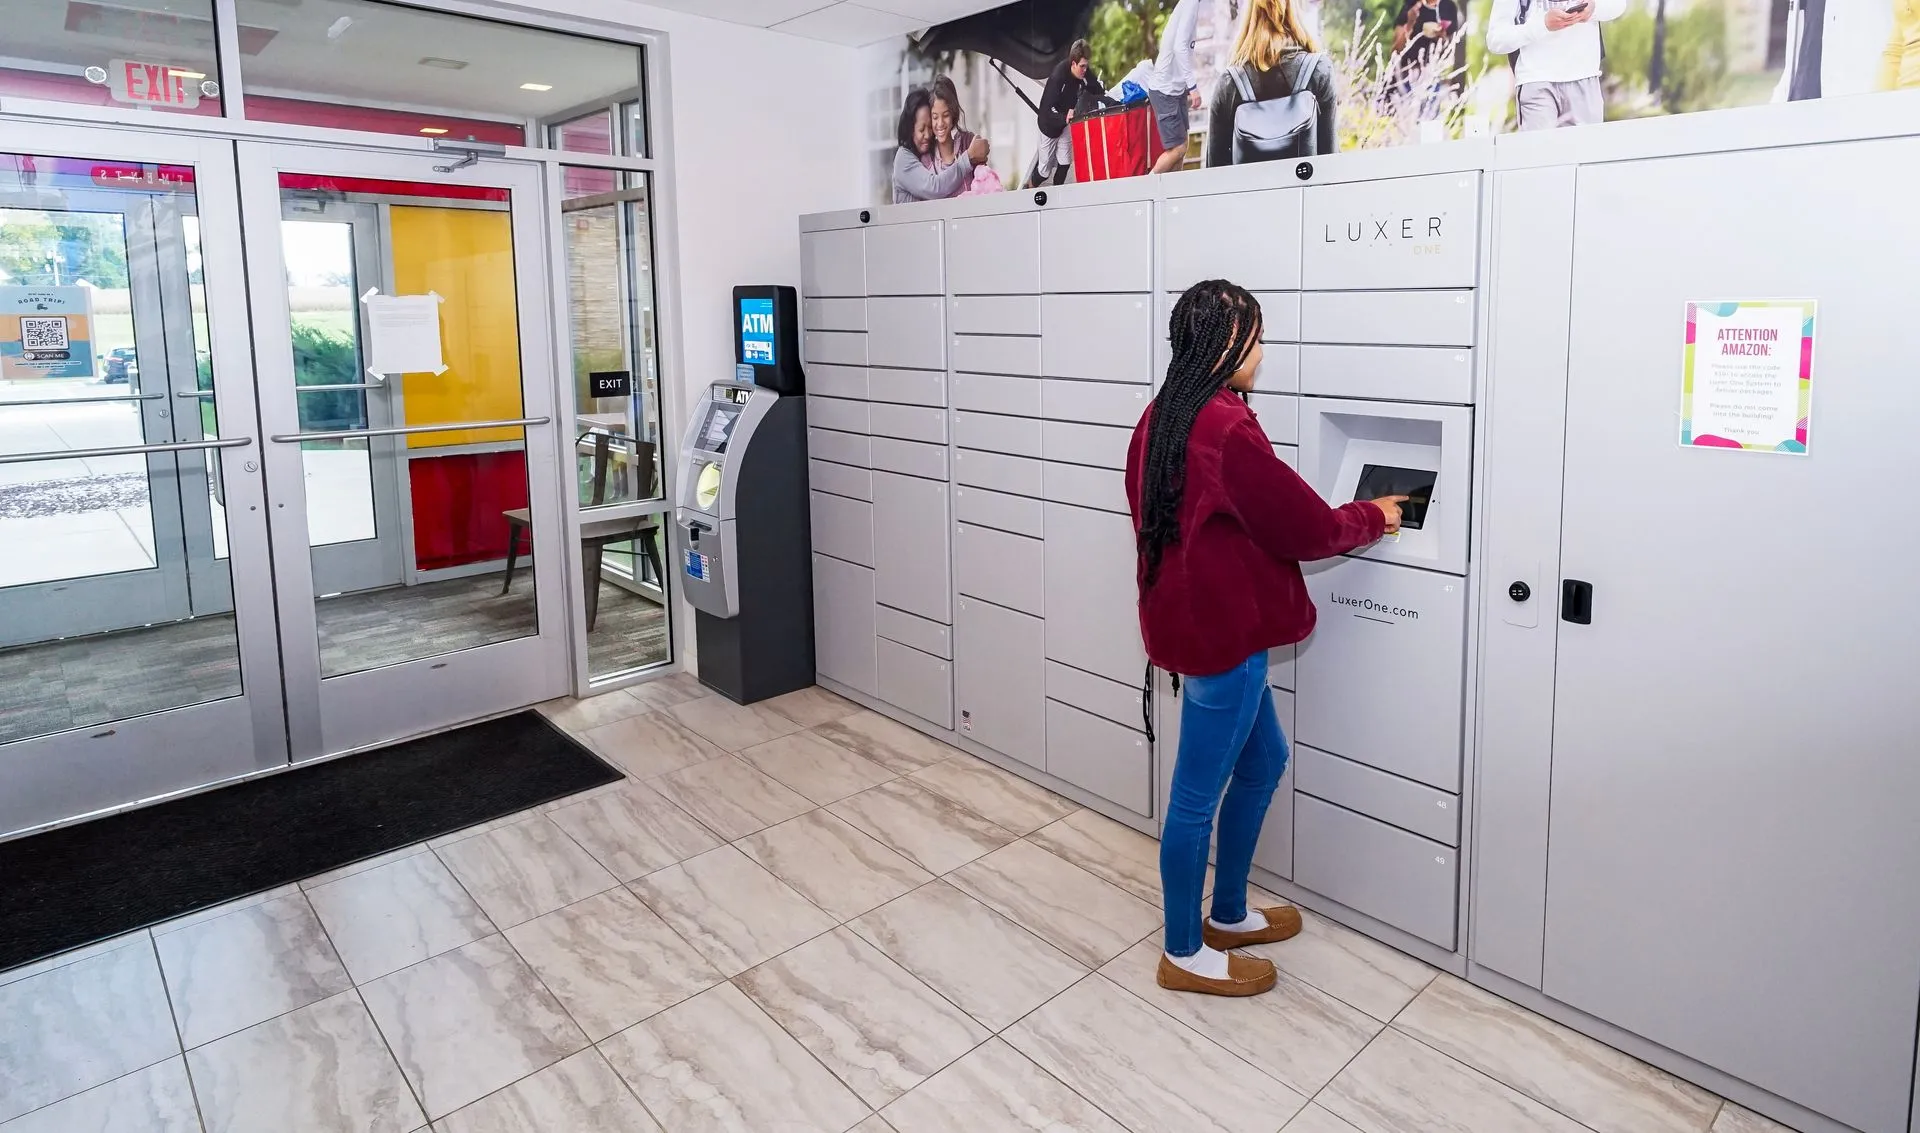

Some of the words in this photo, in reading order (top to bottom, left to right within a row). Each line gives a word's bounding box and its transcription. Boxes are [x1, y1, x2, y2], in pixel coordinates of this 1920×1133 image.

[125, 62, 188, 104] EXIT
[1325, 216, 1442, 243] LUXER
[1413, 244, 1441, 256] ONE
[18, 297, 40, 305] ROAD
[742, 313, 774, 334] ATM
[1717, 328, 1778, 342] ATTENTION
[1721, 343, 1772, 356] AMAZON:
[599, 378, 623, 389] EXIT
[1331, 592, 1419, 619] LuxerOne.com
